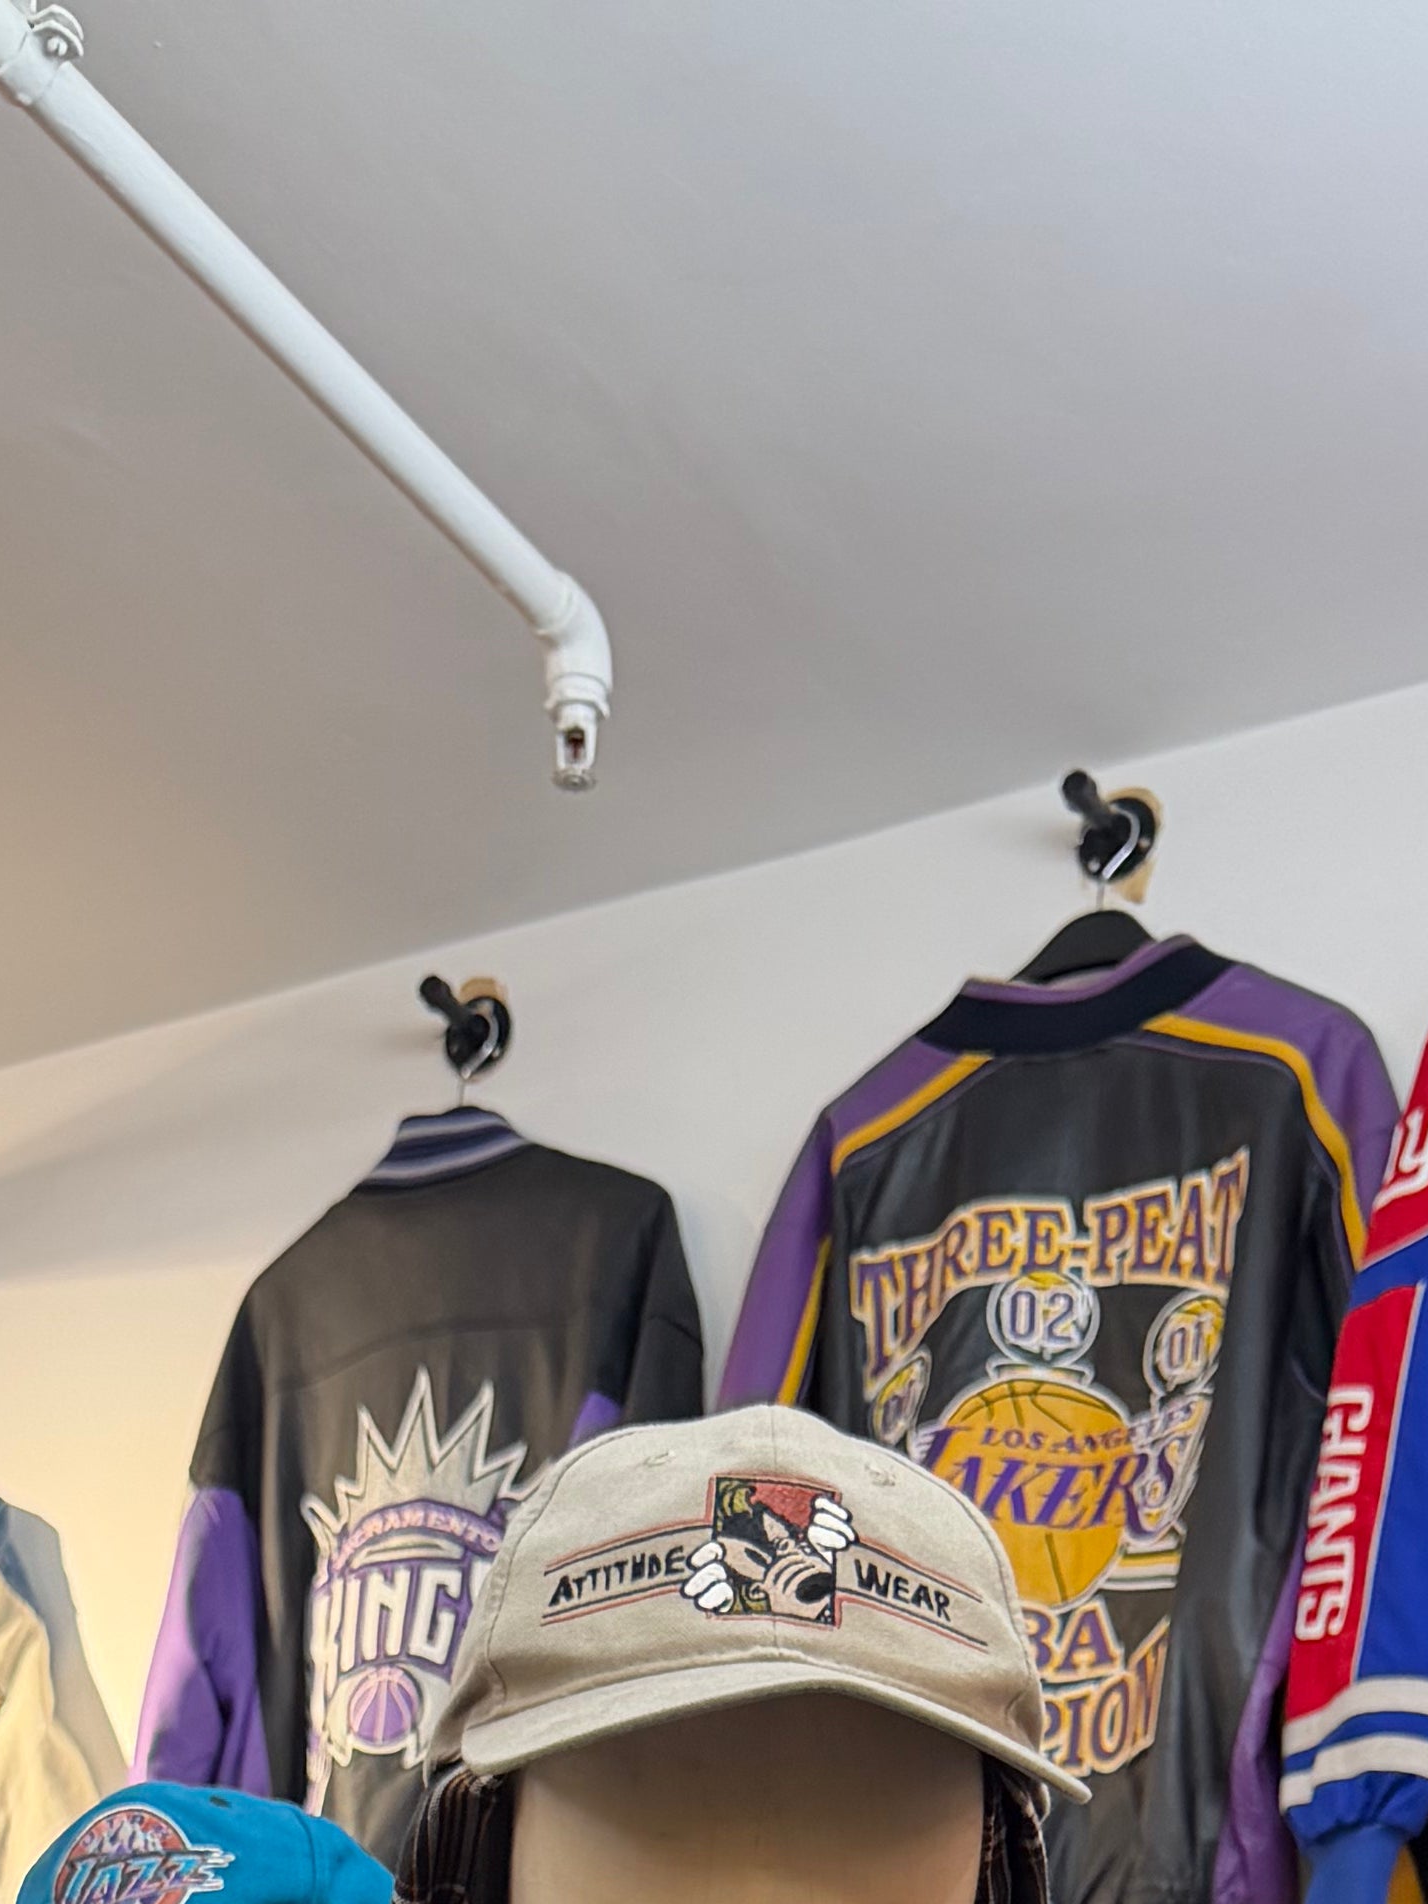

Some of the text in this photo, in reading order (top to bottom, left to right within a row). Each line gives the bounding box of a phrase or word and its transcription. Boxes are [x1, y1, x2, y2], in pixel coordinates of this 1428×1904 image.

[851, 1147, 1250, 1398] THREE-PEAT
[1007, 1288, 1075, 1343] 02
[981, 1427, 1046, 1453] LOS
[908, 1425, 1195, 1537] LAKERS
[1294, 1385, 1374, 1643] GIANTS
[548, 1545, 953, 1623] ATTITUDE WEAR
[1021, 1602, 1125, 1678] BA
